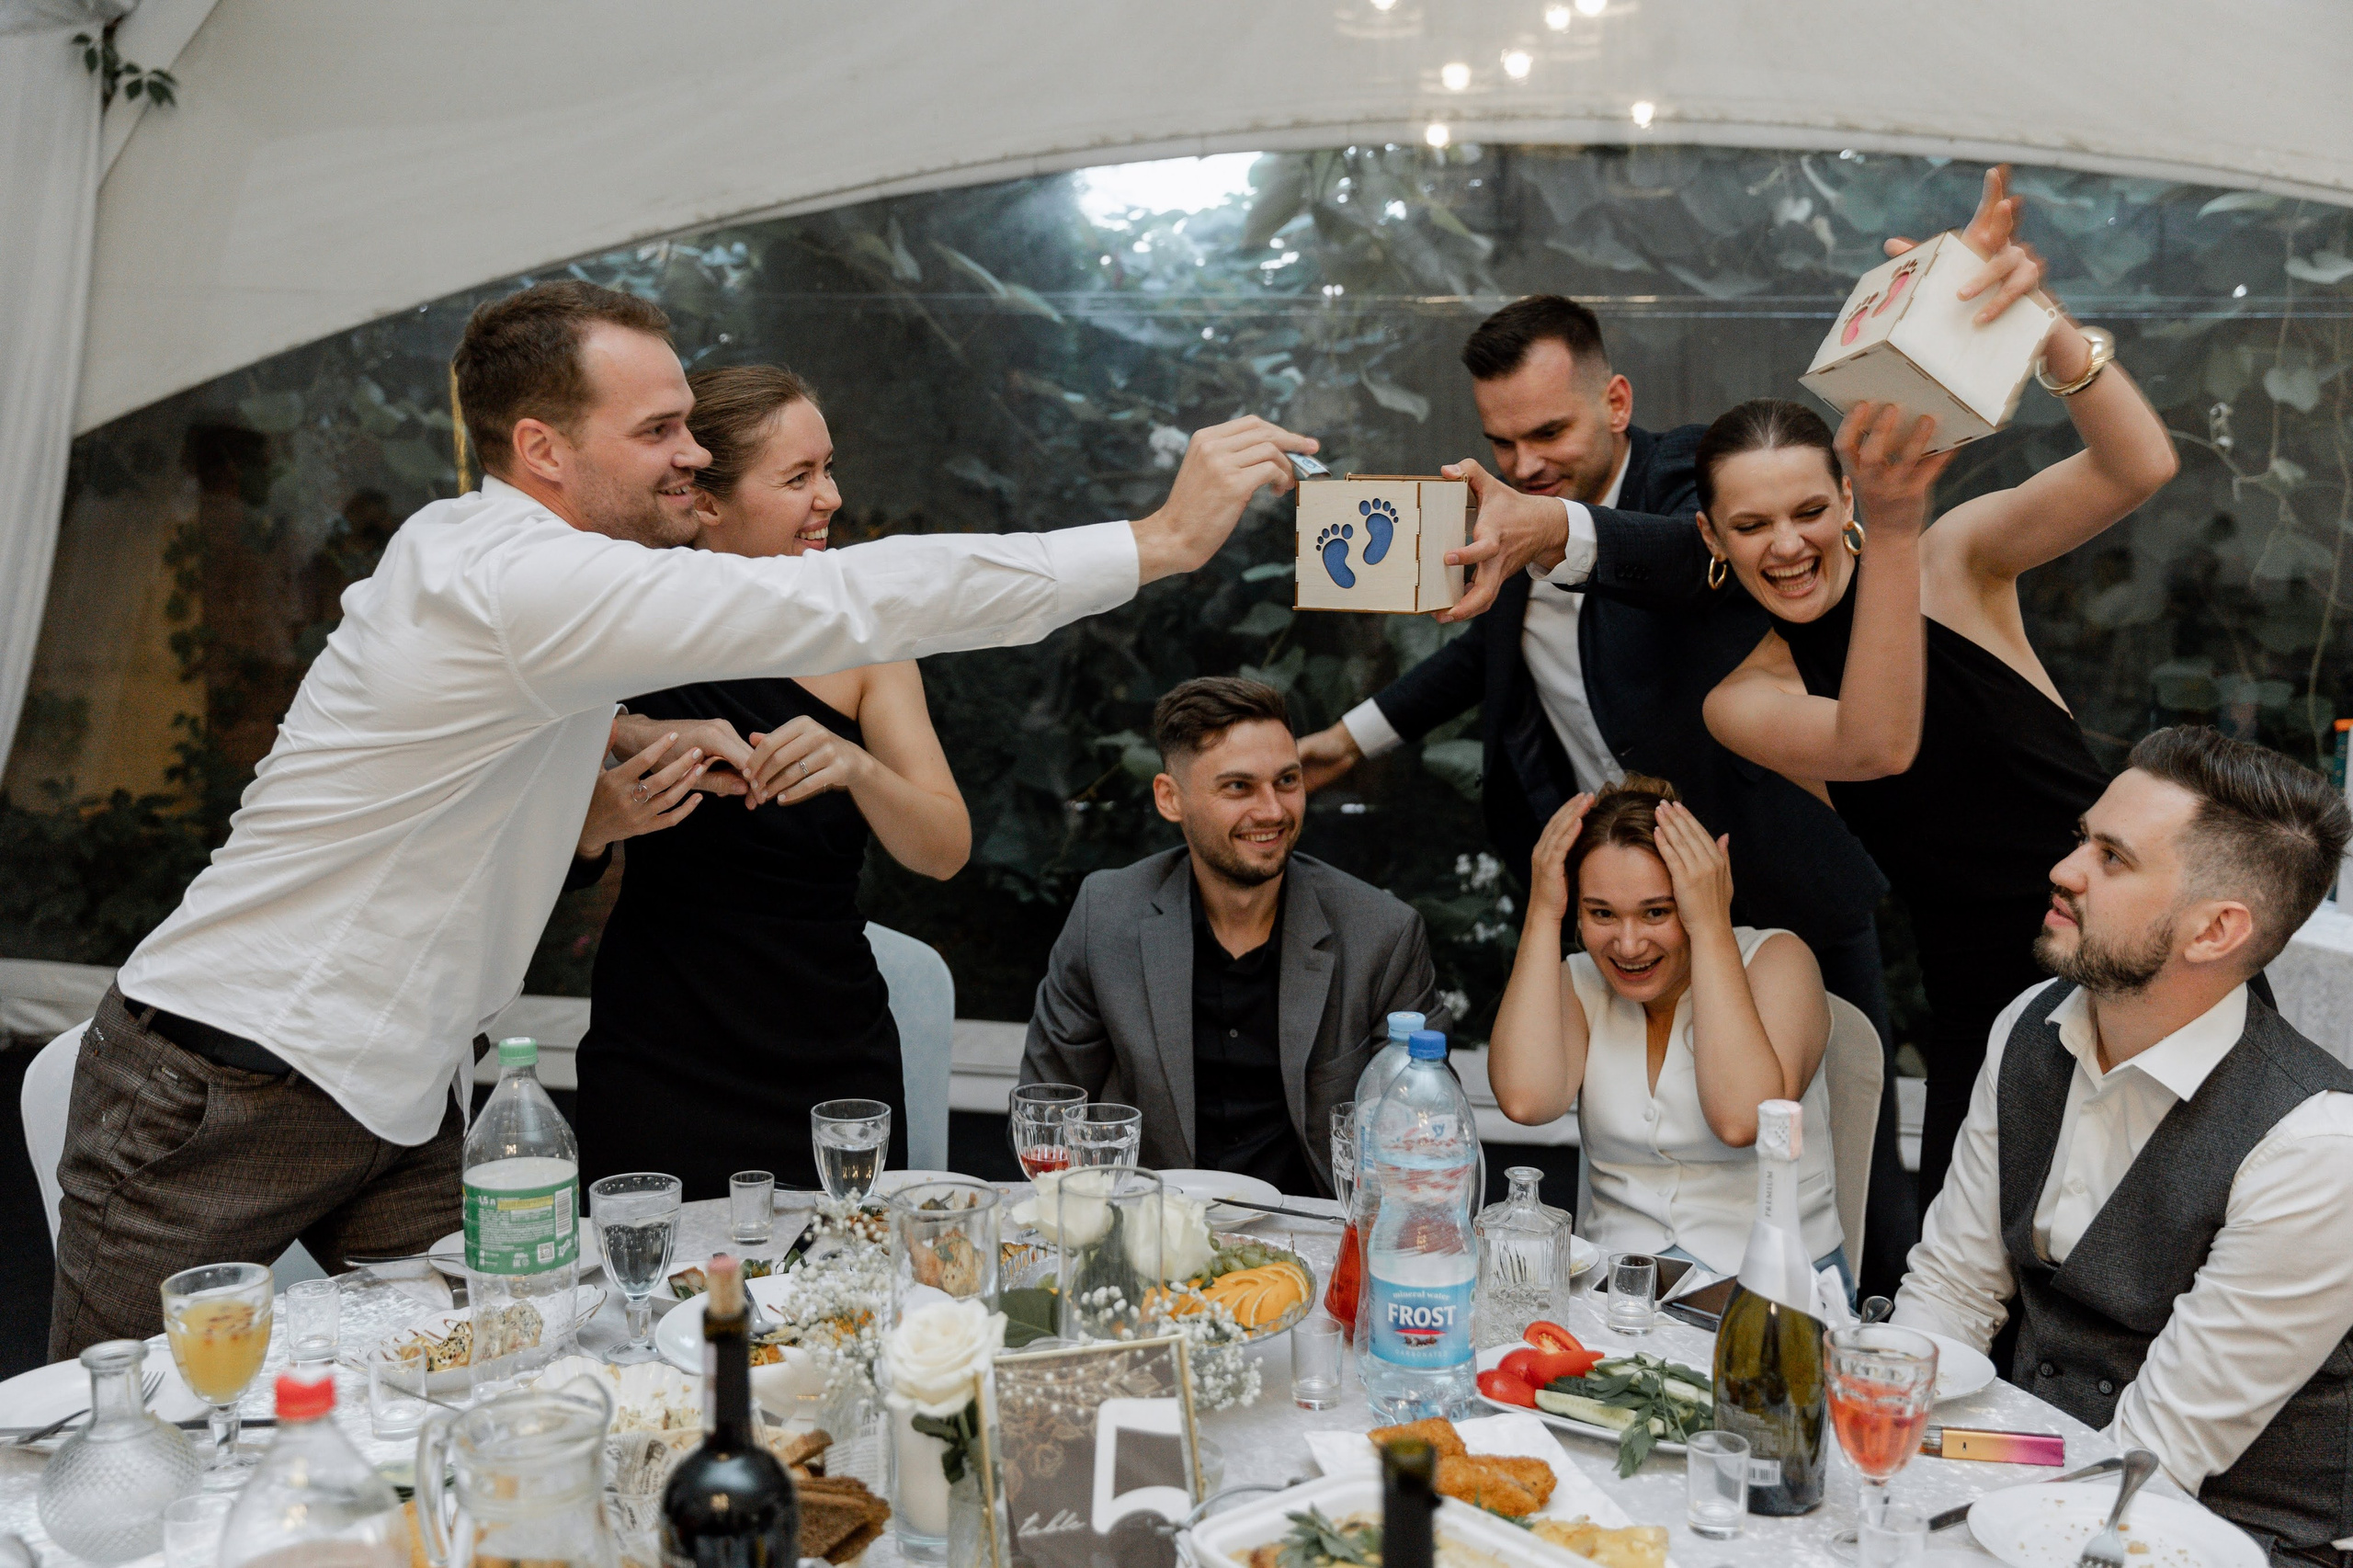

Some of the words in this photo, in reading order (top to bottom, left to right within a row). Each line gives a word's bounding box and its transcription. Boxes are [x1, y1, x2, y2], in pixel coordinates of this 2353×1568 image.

[1765, 1170, 1774, 1218] PREMIUM
[1392, 1290, 1426, 1300] mineral
[1427, 1291, 1450, 1301] water
[1387, 1301, 1457, 1328] FROST
[1092, 1396, 1193, 1535] 5
